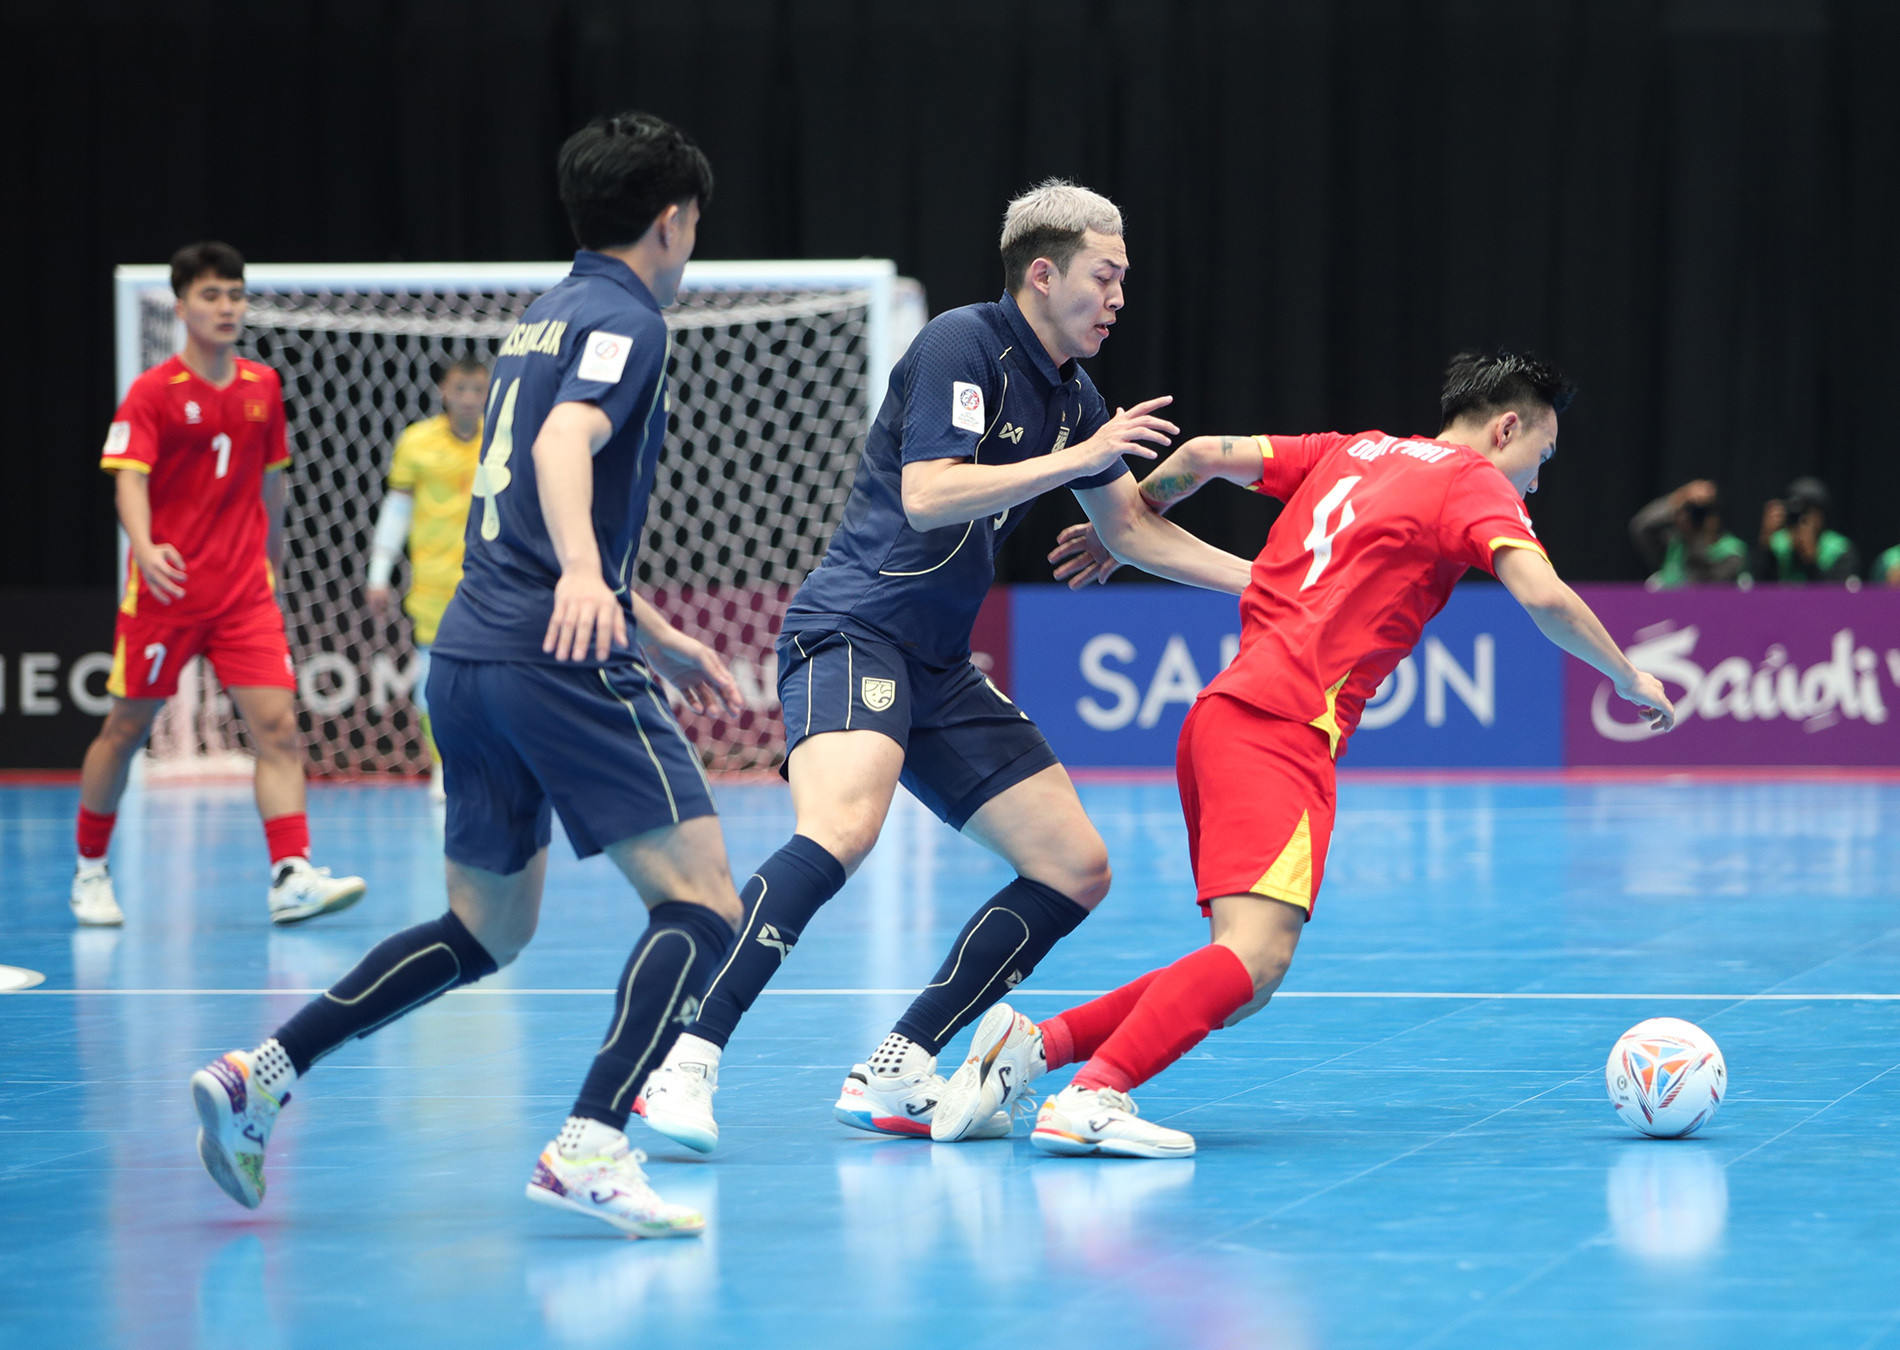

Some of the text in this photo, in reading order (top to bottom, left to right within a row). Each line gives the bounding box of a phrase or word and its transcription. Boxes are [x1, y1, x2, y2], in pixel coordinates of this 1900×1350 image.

[1300, 475, 1362, 593] 4
[144, 642, 167, 685] 7
[1591, 621, 1888, 742] Saudi
